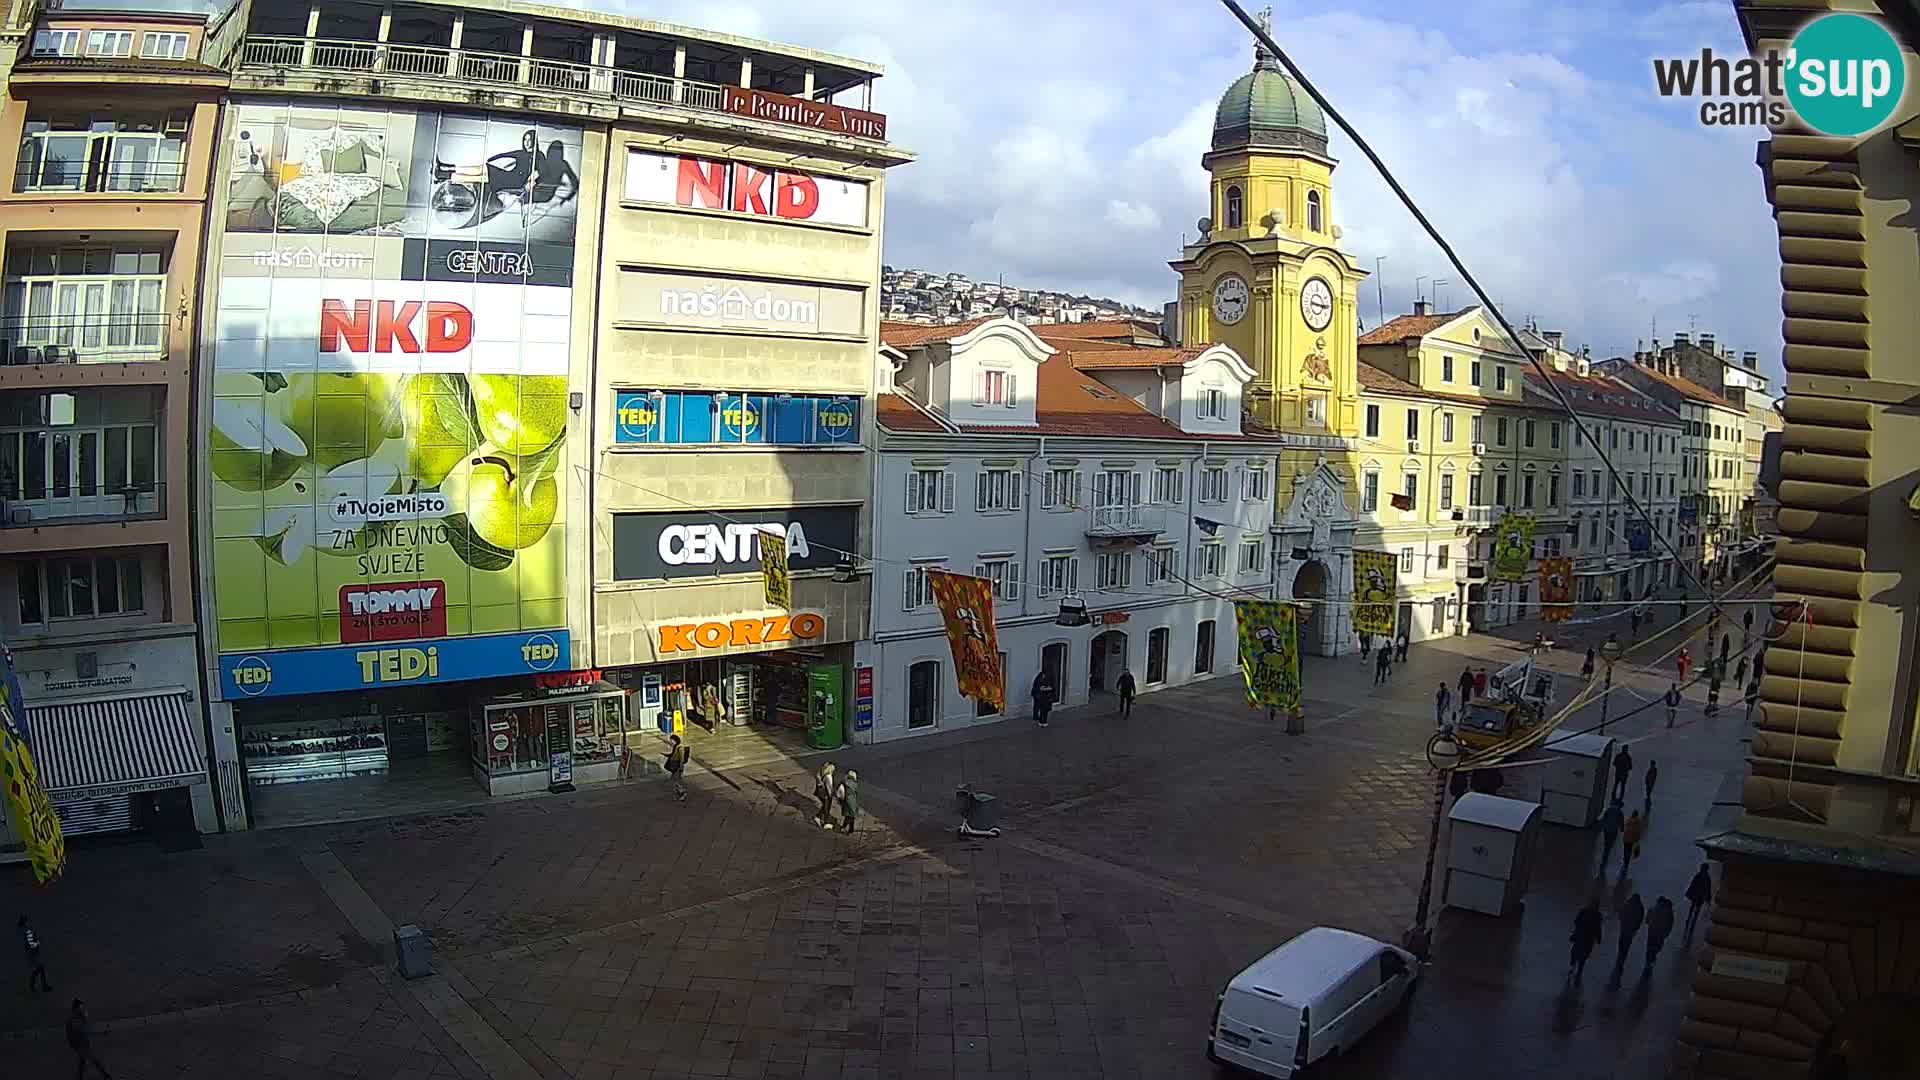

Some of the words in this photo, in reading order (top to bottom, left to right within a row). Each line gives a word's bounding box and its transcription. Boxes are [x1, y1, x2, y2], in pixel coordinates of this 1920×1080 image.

[723, 87, 745, 112] Le
[675, 154, 819, 219] NKD
[252, 245, 292, 267] naš
[318, 247, 366, 270] dom
[446, 249, 535, 276] CENTRA
[660, 283, 718, 316] naš
[751, 289, 817, 323] dom
[320, 298, 475, 354] NKD
[618, 407, 657, 426] TEDi
[723, 409, 759, 426] TEDi
[819, 411, 853, 427] TEDi
[337, 497, 446, 516] #TvojeMisto
[332, 531, 357, 550] ZA
[364, 525, 450, 549] DNEVNO
[357, 549, 426, 576] SVJEŽE
[347, 587, 438, 615] TOMMY
[658, 612, 827, 653] KORZO
[522, 641, 559, 662] TEDi
[233, 666, 272, 686] TEDi
[355, 646, 440, 684] TEDi
